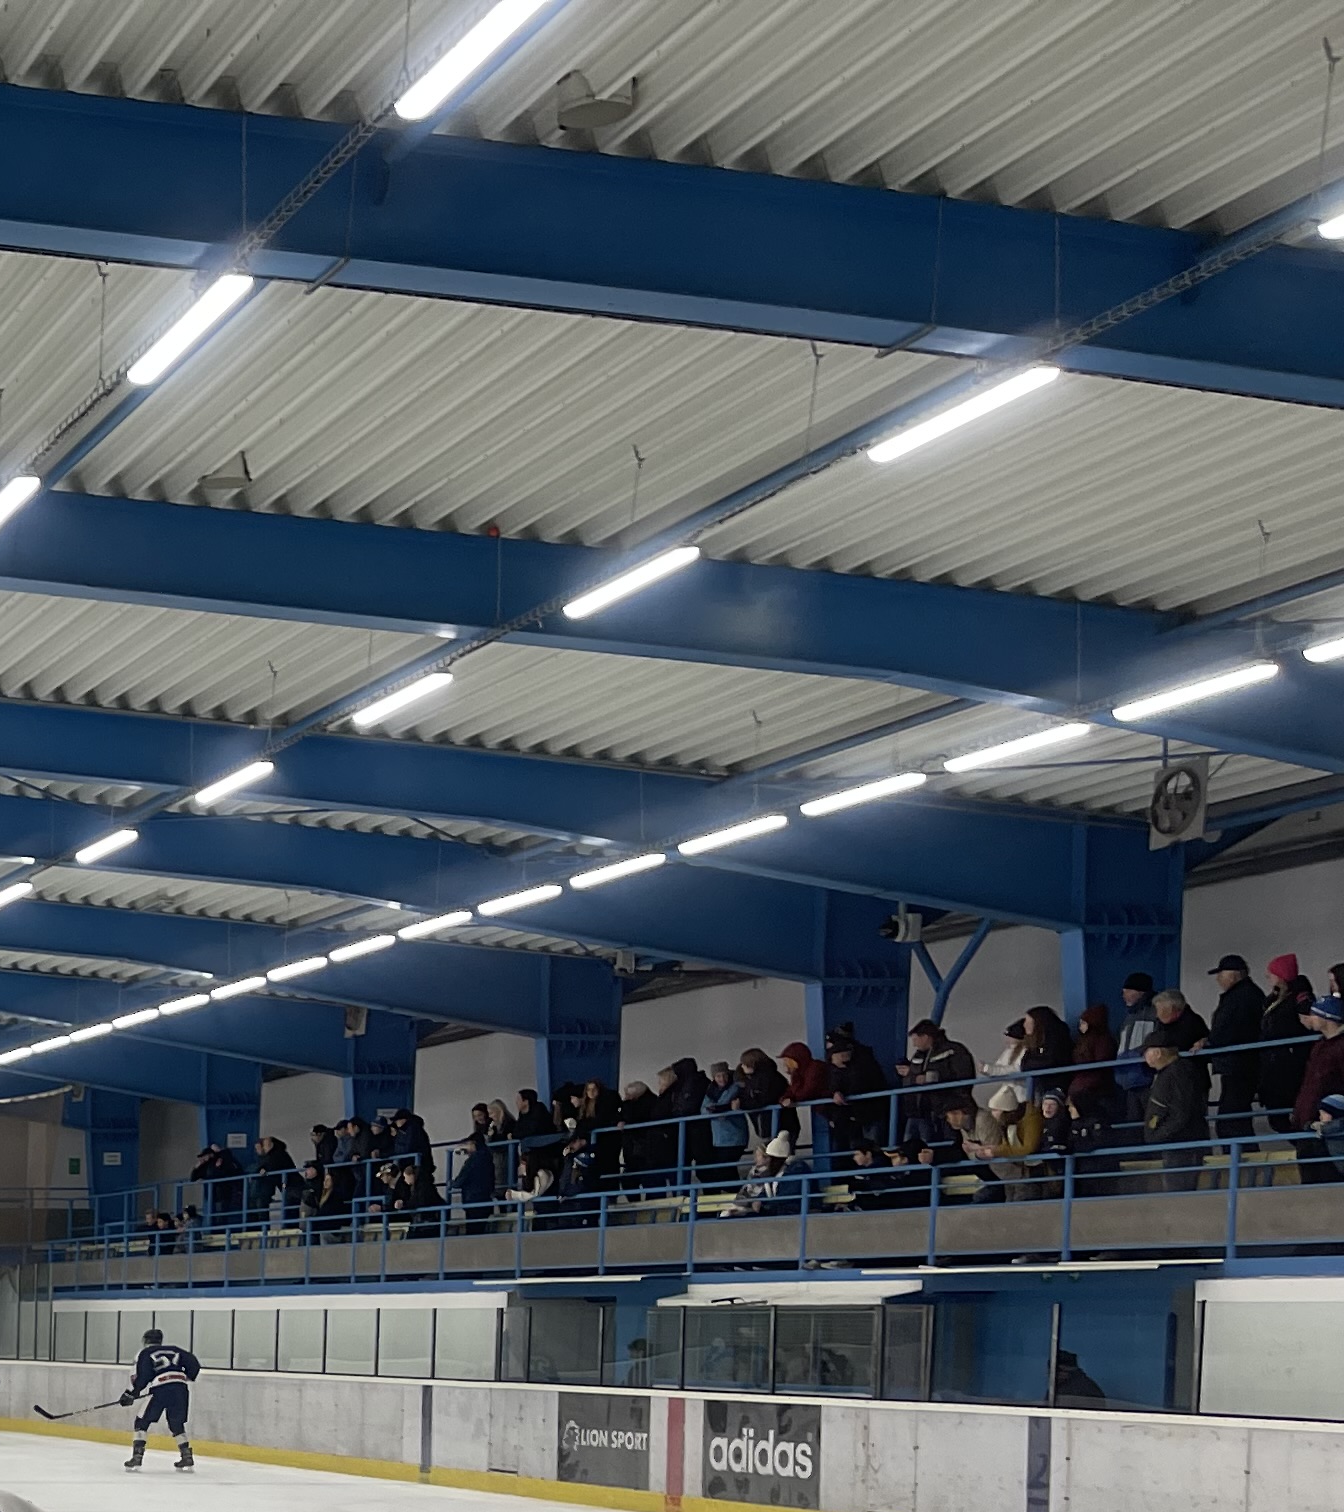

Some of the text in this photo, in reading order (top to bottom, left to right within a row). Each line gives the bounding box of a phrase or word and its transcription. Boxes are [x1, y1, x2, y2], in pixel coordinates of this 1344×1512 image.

[580, 1429, 649, 1451] LION SPORT
[708, 1427, 813, 1479] adidas
